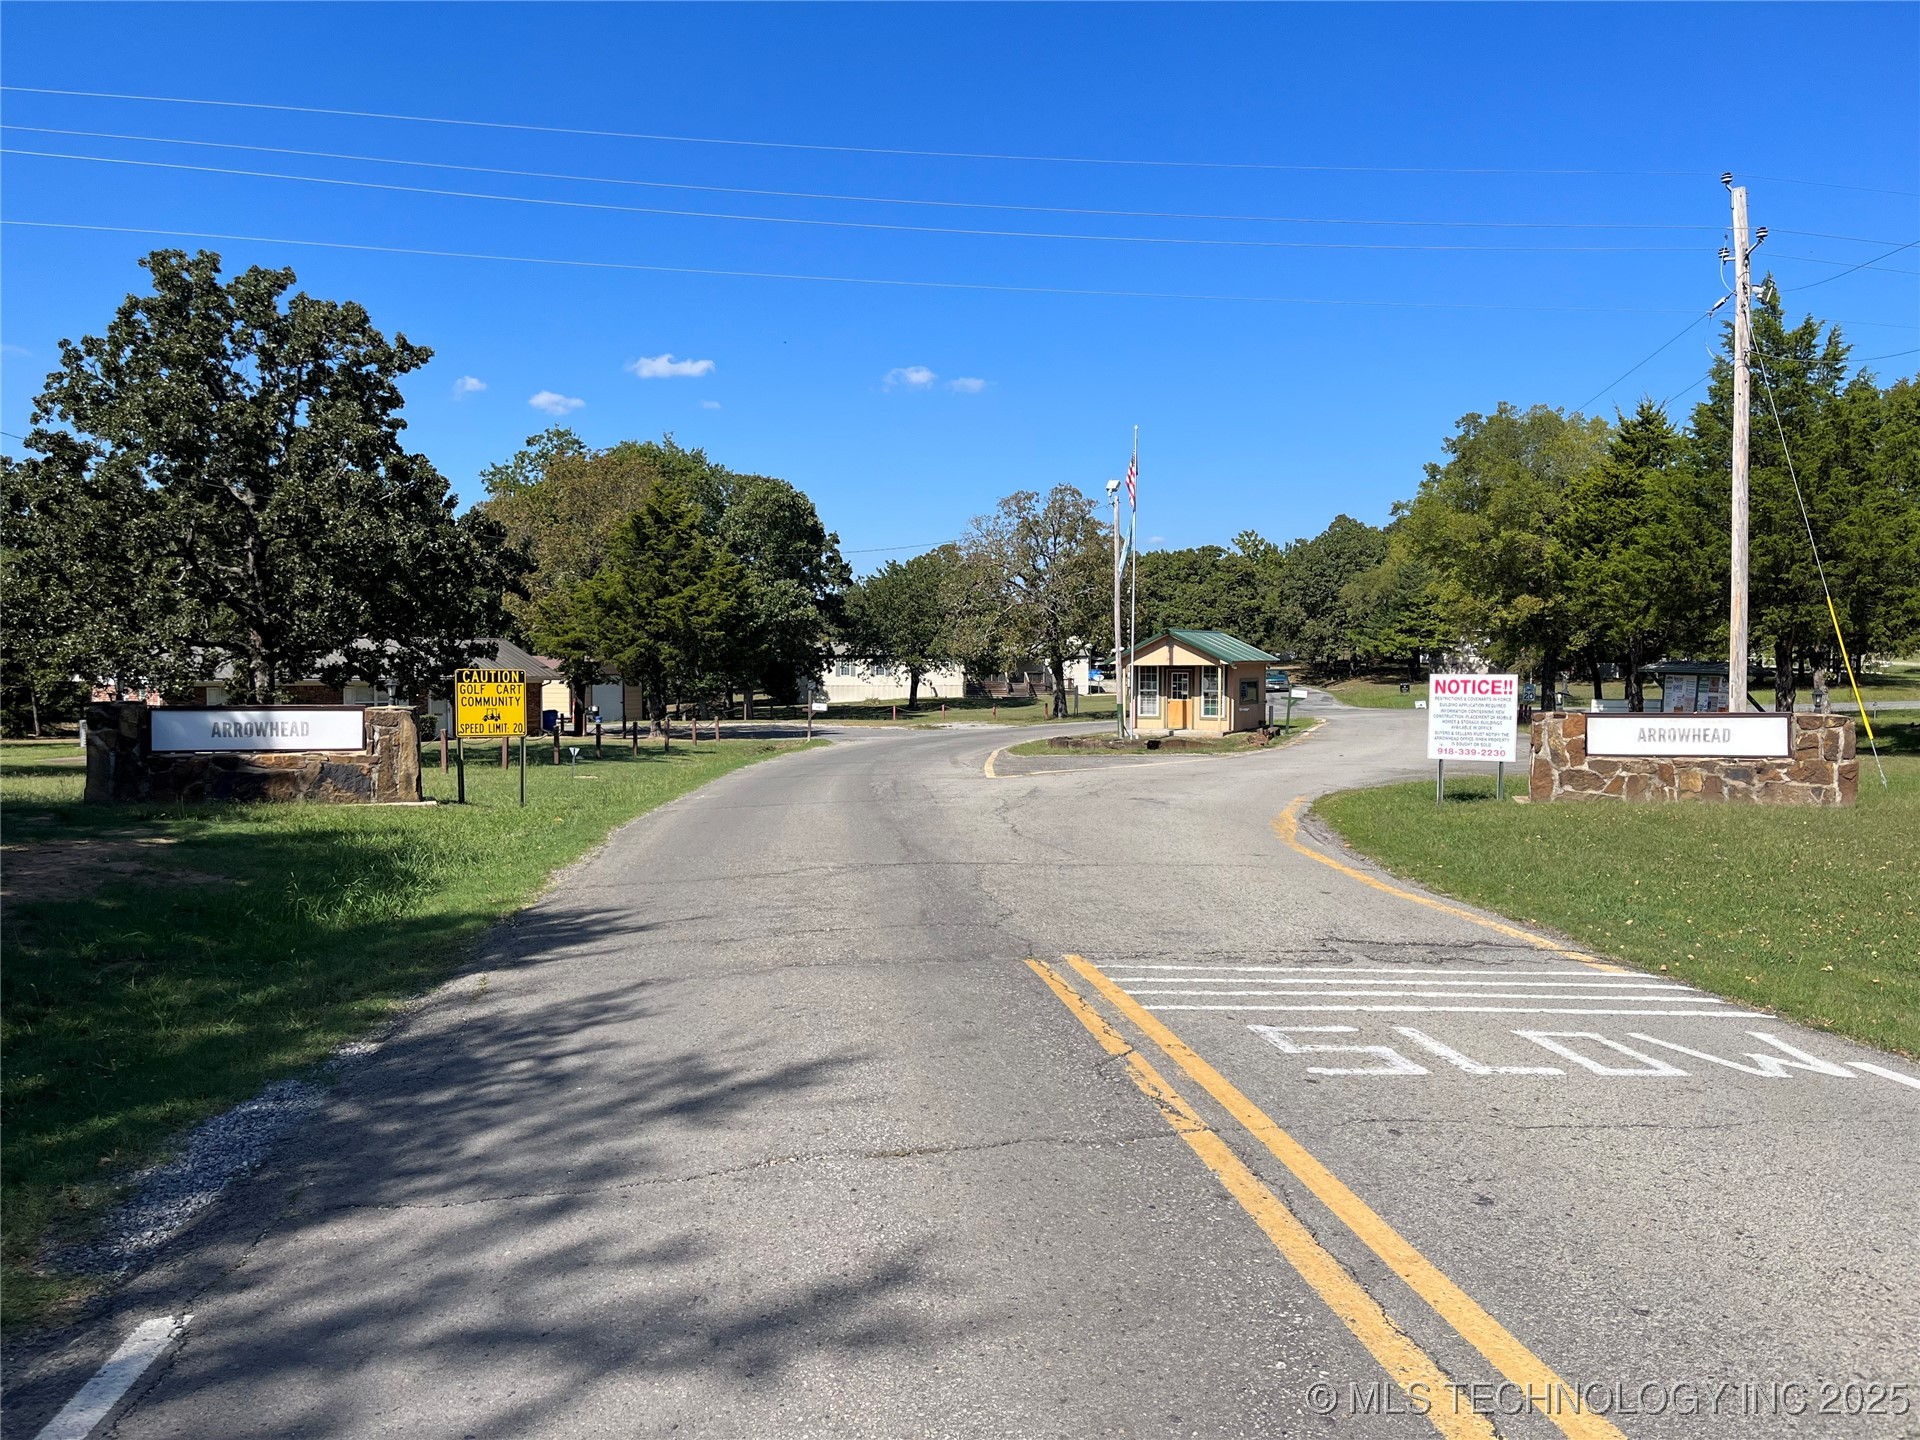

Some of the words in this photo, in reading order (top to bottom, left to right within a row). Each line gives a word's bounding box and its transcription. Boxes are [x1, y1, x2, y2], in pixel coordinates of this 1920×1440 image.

[462, 670, 519, 683] CAUTION
[459, 684, 486, 695] GOLF
[496, 684, 522, 695] CART
[1434, 679, 1513, 695] NOTICE!!
[461, 696, 521, 707] COMMUNITY
[1523, 692, 1534, 700] 20
[210, 721, 310, 738] ARROWHEAD
[459, 723, 485, 734] SPEED
[513, 723, 523, 733] 20
[1637, 727, 1731, 743] ARROWHEAD
[1437, 747, 1506, 757] 918-339-2230
[1246, 1024, 1858, 1079] SLOW
